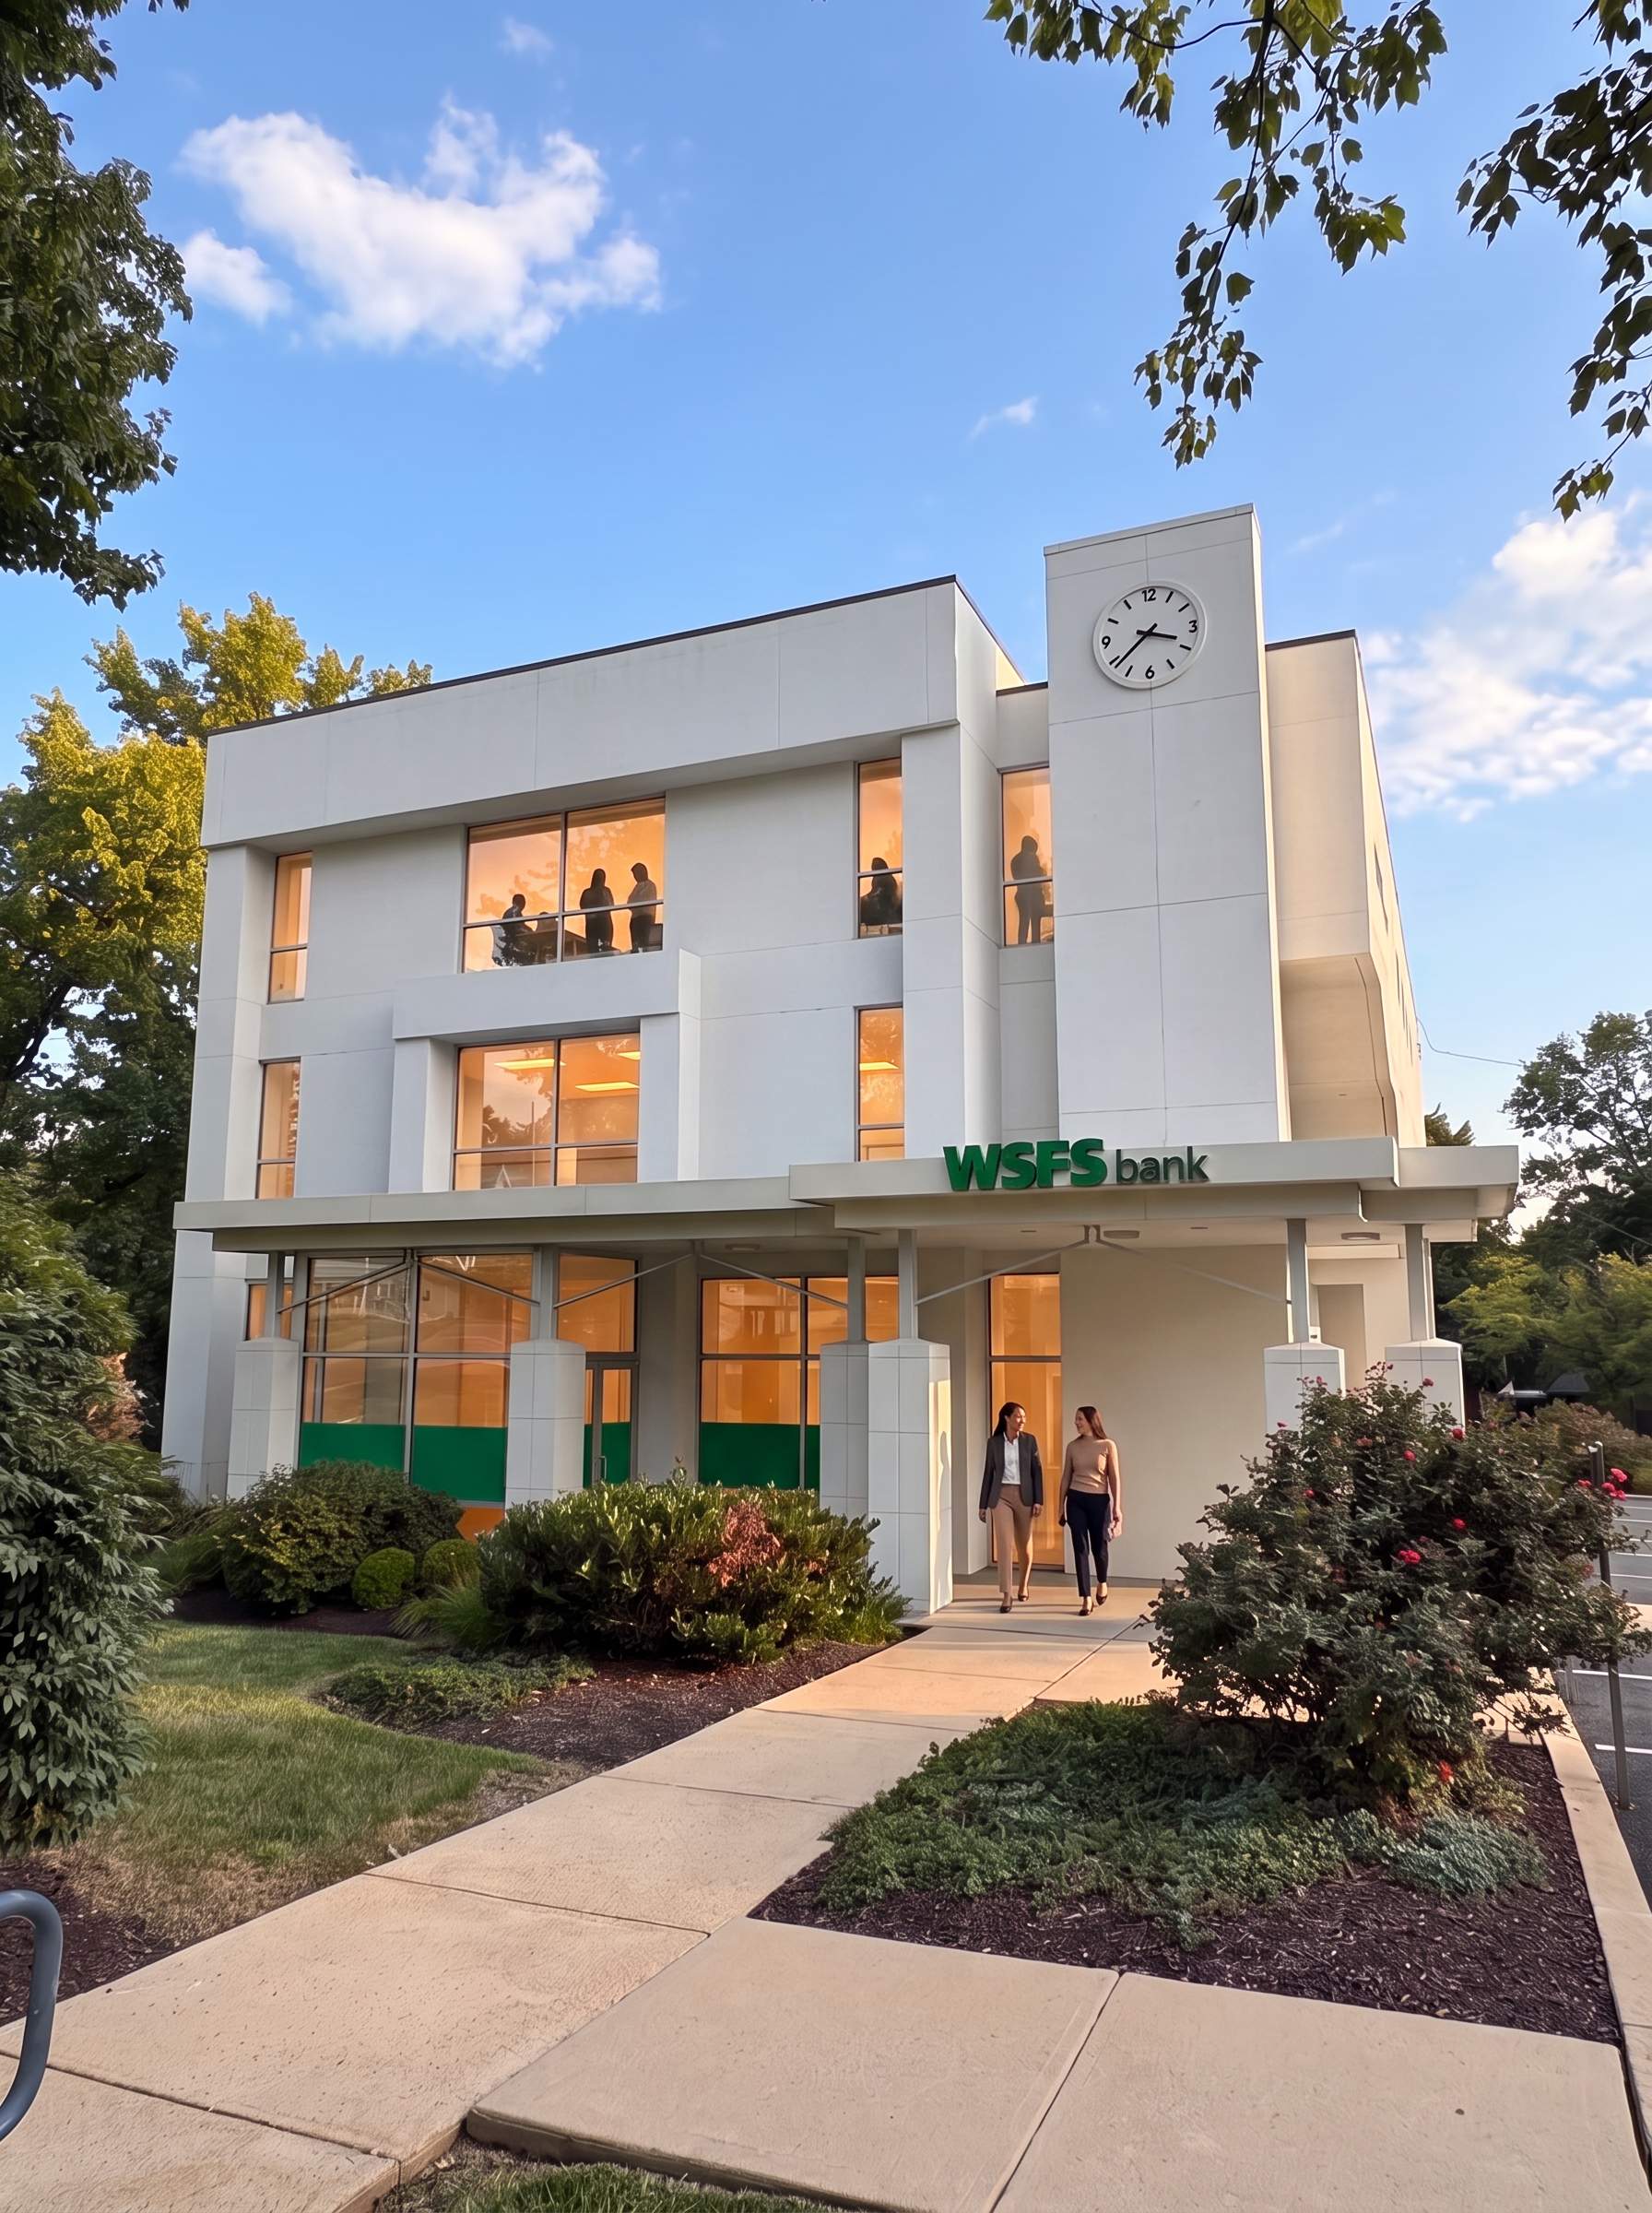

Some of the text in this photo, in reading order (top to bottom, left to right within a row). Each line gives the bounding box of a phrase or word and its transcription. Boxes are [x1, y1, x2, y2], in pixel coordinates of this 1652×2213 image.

[1141, 588, 1156, 602] 12
[1188, 620, 1198, 633] 3
[1102, 635, 1111, 649] 9
[1145, 665, 1155, 680] 6
[942, 1138, 1210, 1191] WSFS bank
